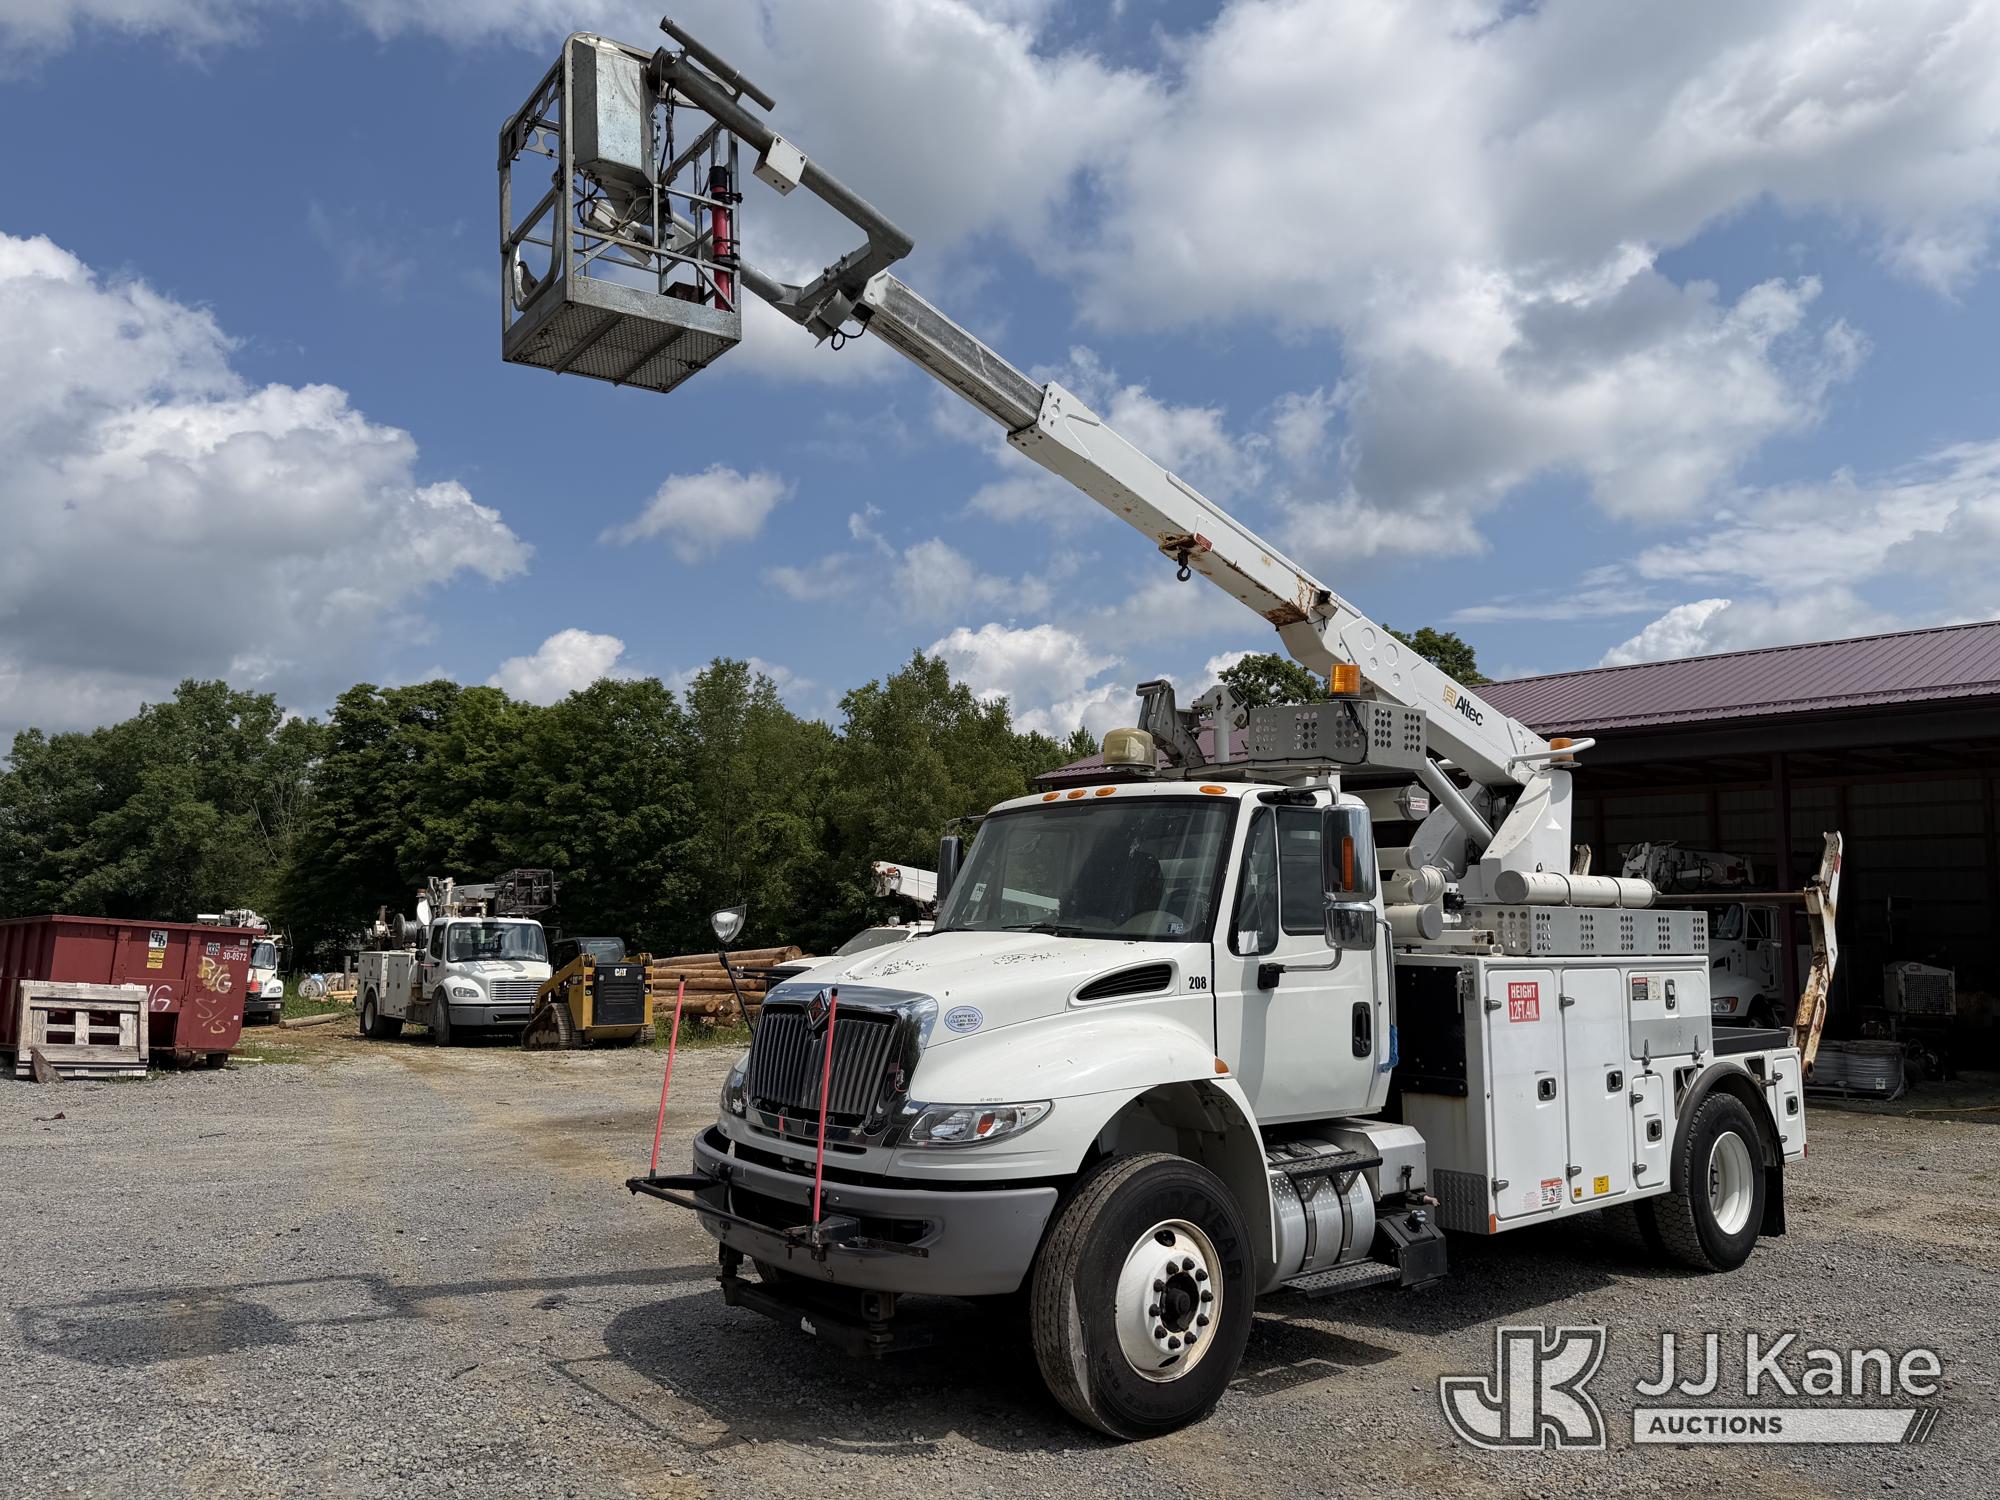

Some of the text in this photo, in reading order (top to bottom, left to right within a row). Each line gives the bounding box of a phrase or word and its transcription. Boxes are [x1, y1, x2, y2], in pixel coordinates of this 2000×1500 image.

[1455, 695, 1484, 726] Altec
[223, 951, 248, 961] 30-0572
[614, 968, 628, 977] CAT
[1188, 976, 1207, 989] 208
[1510, 984, 1536, 999] HEIGHT
